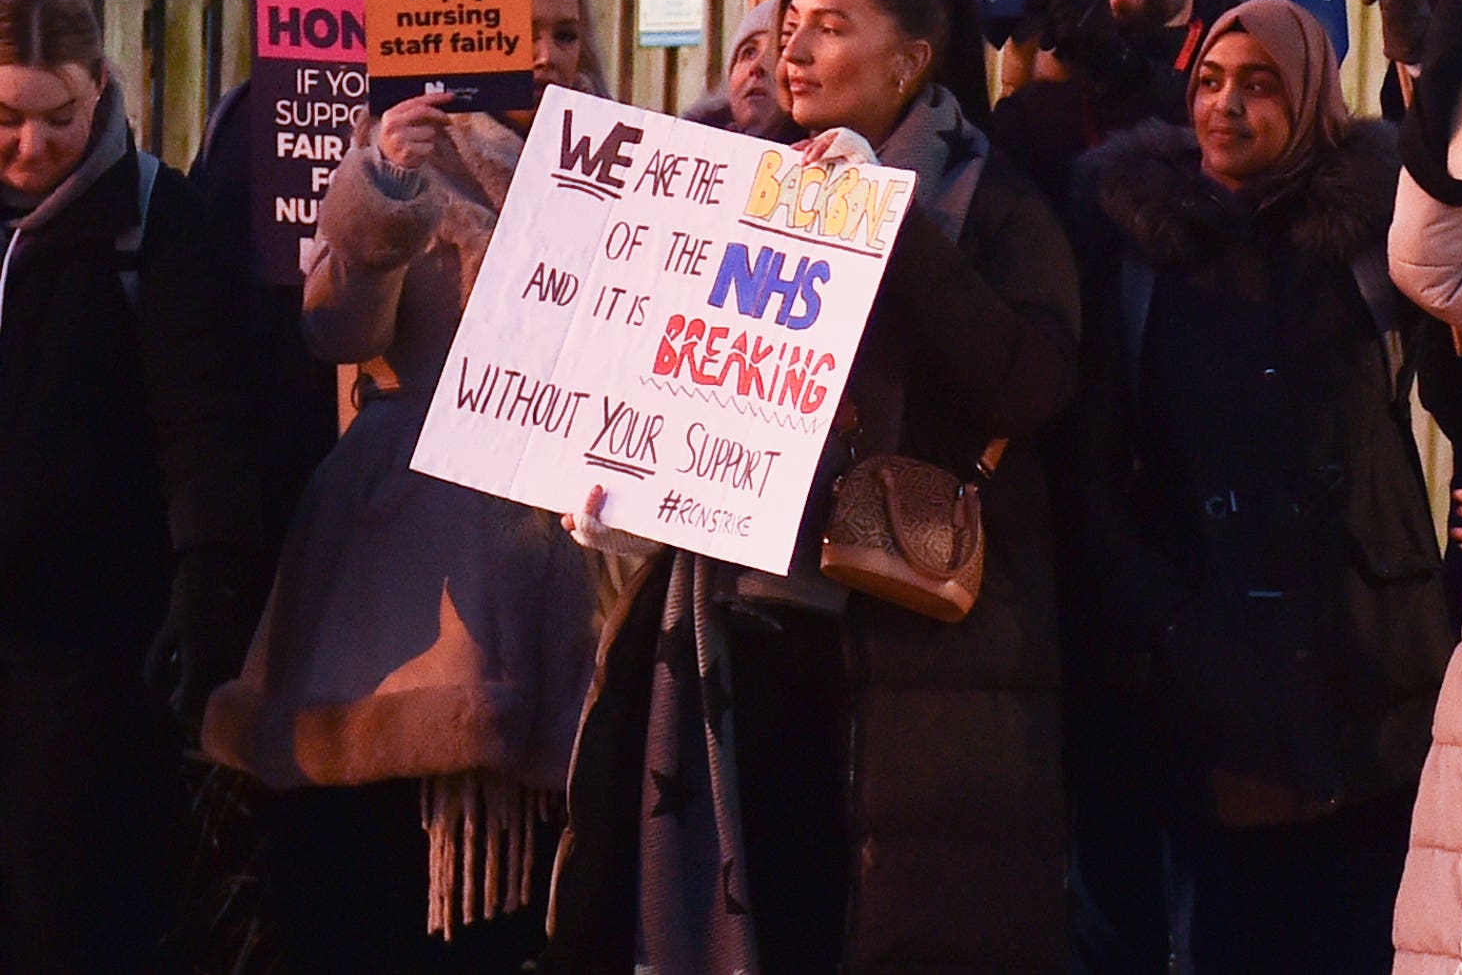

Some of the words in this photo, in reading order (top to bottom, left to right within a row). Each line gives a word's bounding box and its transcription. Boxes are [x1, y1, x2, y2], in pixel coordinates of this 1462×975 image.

[379, 33, 443, 57] staff
[449, 30, 520, 55] fairly
[396, 3, 501, 28] nursing
[296, 68, 319, 96] IF
[276, 131, 343, 162] FAIR
[559, 108, 644, 189] WE
[633, 147, 684, 198] ARE
[684, 156, 729, 205] THE
[743, 148, 910, 251] BACKBONE
[521, 260, 580, 308] AND
[592, 284, 627, 322] IT
[626, 293, 651, 326] IS
[605, 220, 650, 262] OF
[664, 231, 713, 277] THE
[707, 241, 831, 328] NHS
[651, 313, 837, 414] BREAKING
[456, 356, 590, 439] WITHOUT
[588, 396, 664, 465] YOUR
[676, 422, 782, 499] SUPPORT
